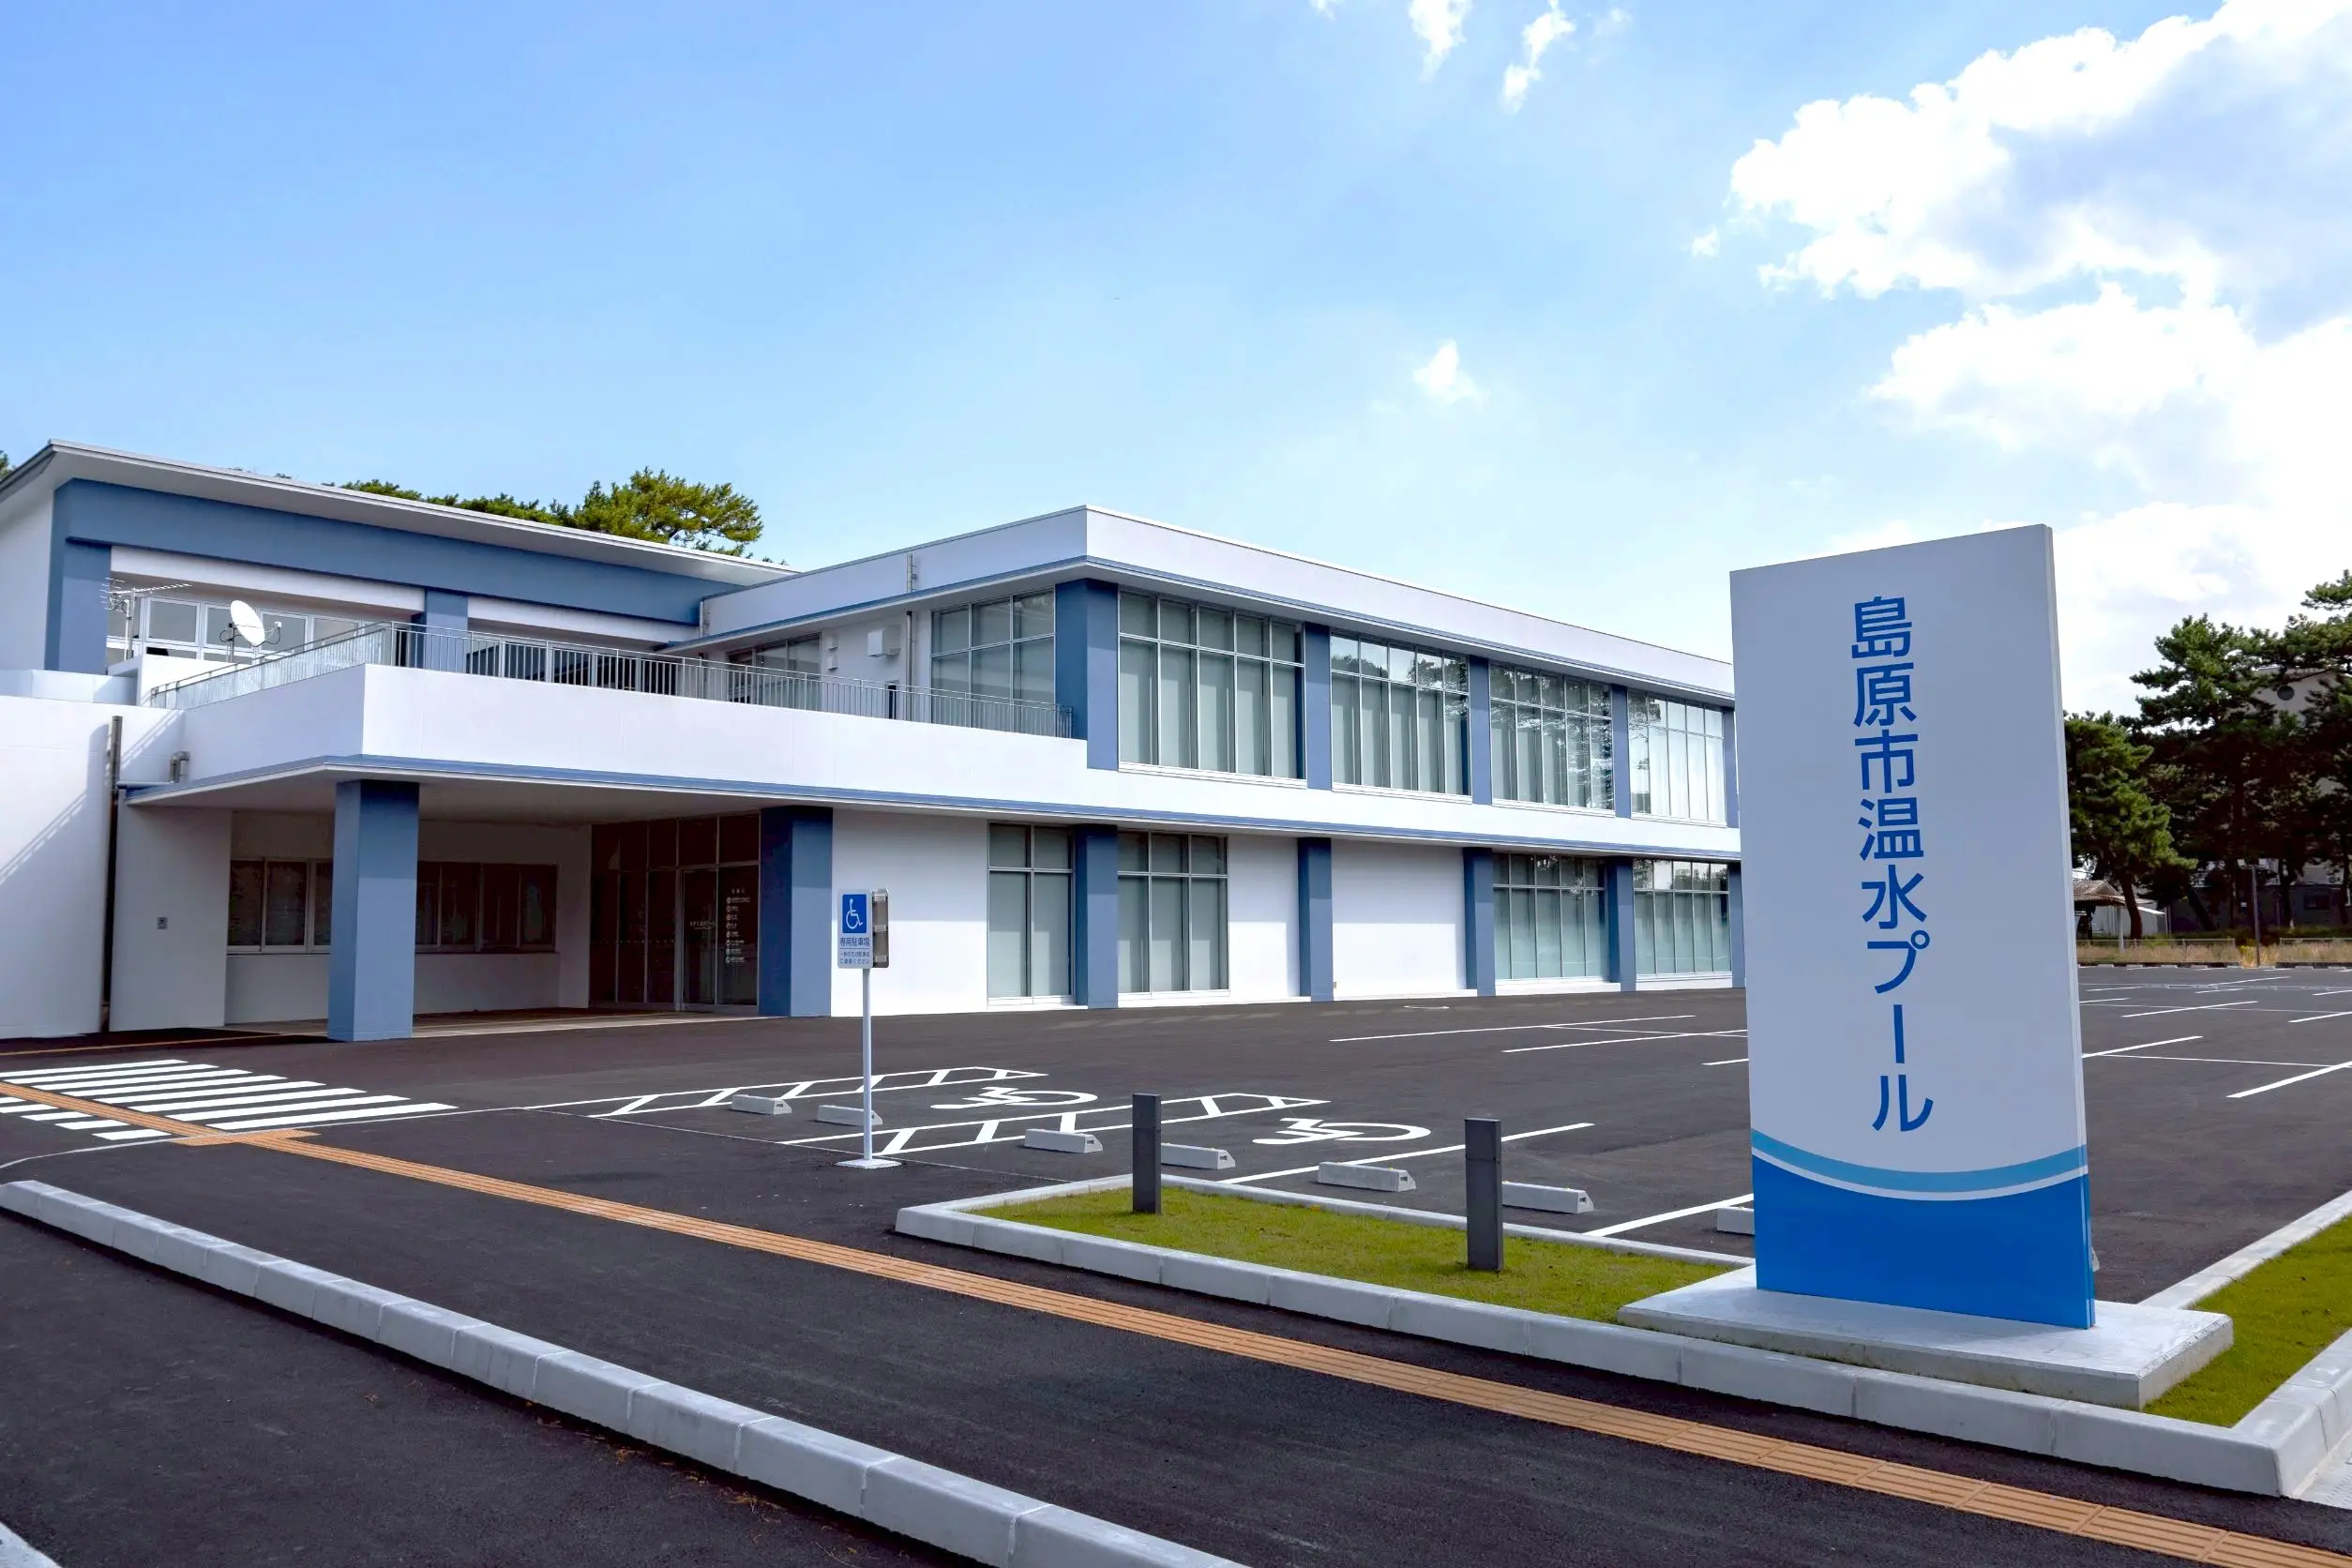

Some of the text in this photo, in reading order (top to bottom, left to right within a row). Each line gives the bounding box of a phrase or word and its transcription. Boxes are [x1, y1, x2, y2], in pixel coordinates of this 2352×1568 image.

[840, 938, 870, 947] 専用駐車場
[1851, 596, 1933, 1131] 島原市温水プール
